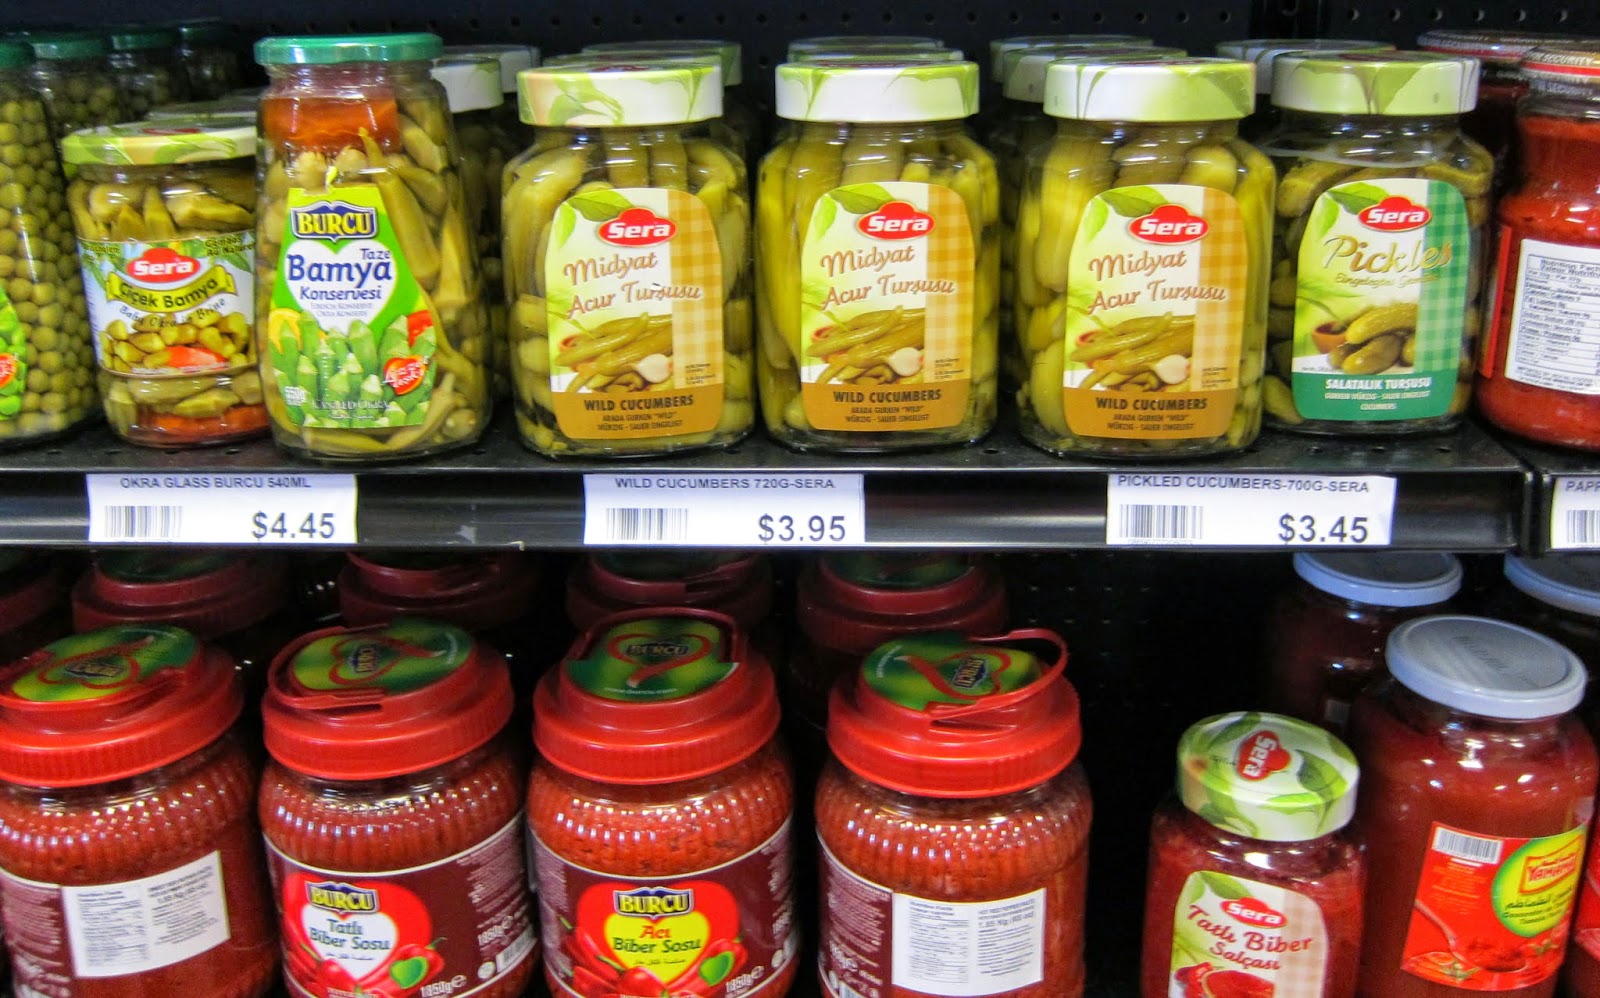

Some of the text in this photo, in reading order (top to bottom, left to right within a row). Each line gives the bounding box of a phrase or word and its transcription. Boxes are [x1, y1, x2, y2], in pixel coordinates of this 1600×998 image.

[296, 211, 372, 236] BURCU
[867, 216, 930, 232] Sera
[1366, 208, 1425, 224] Sera
[608, 222, 671, 238] Sera
[1139, 219, 1203, 236] Sera
[360, 248, 392, 260] Taze
[820, 246, 915, 278] Midyat
[1324, 234, 1453, 273] Pickles
[134, 261, 193, 276] Sera
[286, 254, 393, 289] Bamya
[563, 251, 659, 286] Midyat
[1088, 250, 1187, 282] Midyat
[164, 278, 218, 308] Bamya
[300, 286, 382, 301] Konservesi
[821, 273, 955, 310] Acur Turşusu
[1087, 279, 1226, 315] Acur Turşusu
[566, 293, 616, 320] Acur
[584, 395, 694, 411] WILD CUCUMBERS
[833, 389, 941, 403] WILD CUCUMBERS
[1096, 398, 1208, 411] WILD CUCUMBERS
[120, 477, 312, 489] OKRA GLASS BURCU 540ML
[615, 478, 835, 489] WILD CUCUMBERS 720G-SERA
[1118, 475, 1369, 493] PICKLED CUCUMBERS-700G-SERA
[251, 510, 336, 541] $4.45
[758, 513, 846, 544] $3.95
[1278, 512, 1369, 544] $3.45
[1242, 735, 1276, 778] Sera
[312, 886, 374, 910] BURCU
[618, 893, 689, 913] BURCU
[1226, 902, 1282, 924] Sera
[326, 918, 363, 935] Tatlı
[639, 925, 670, 939] Acı
[1187, 904, 1313, 953] Tatlı Biber
[310, 927, 391, 950] Biber Sosu
[613, 938, 701, 953] Biber Sosu
[1210, 941, 1282, 970] Salçası
